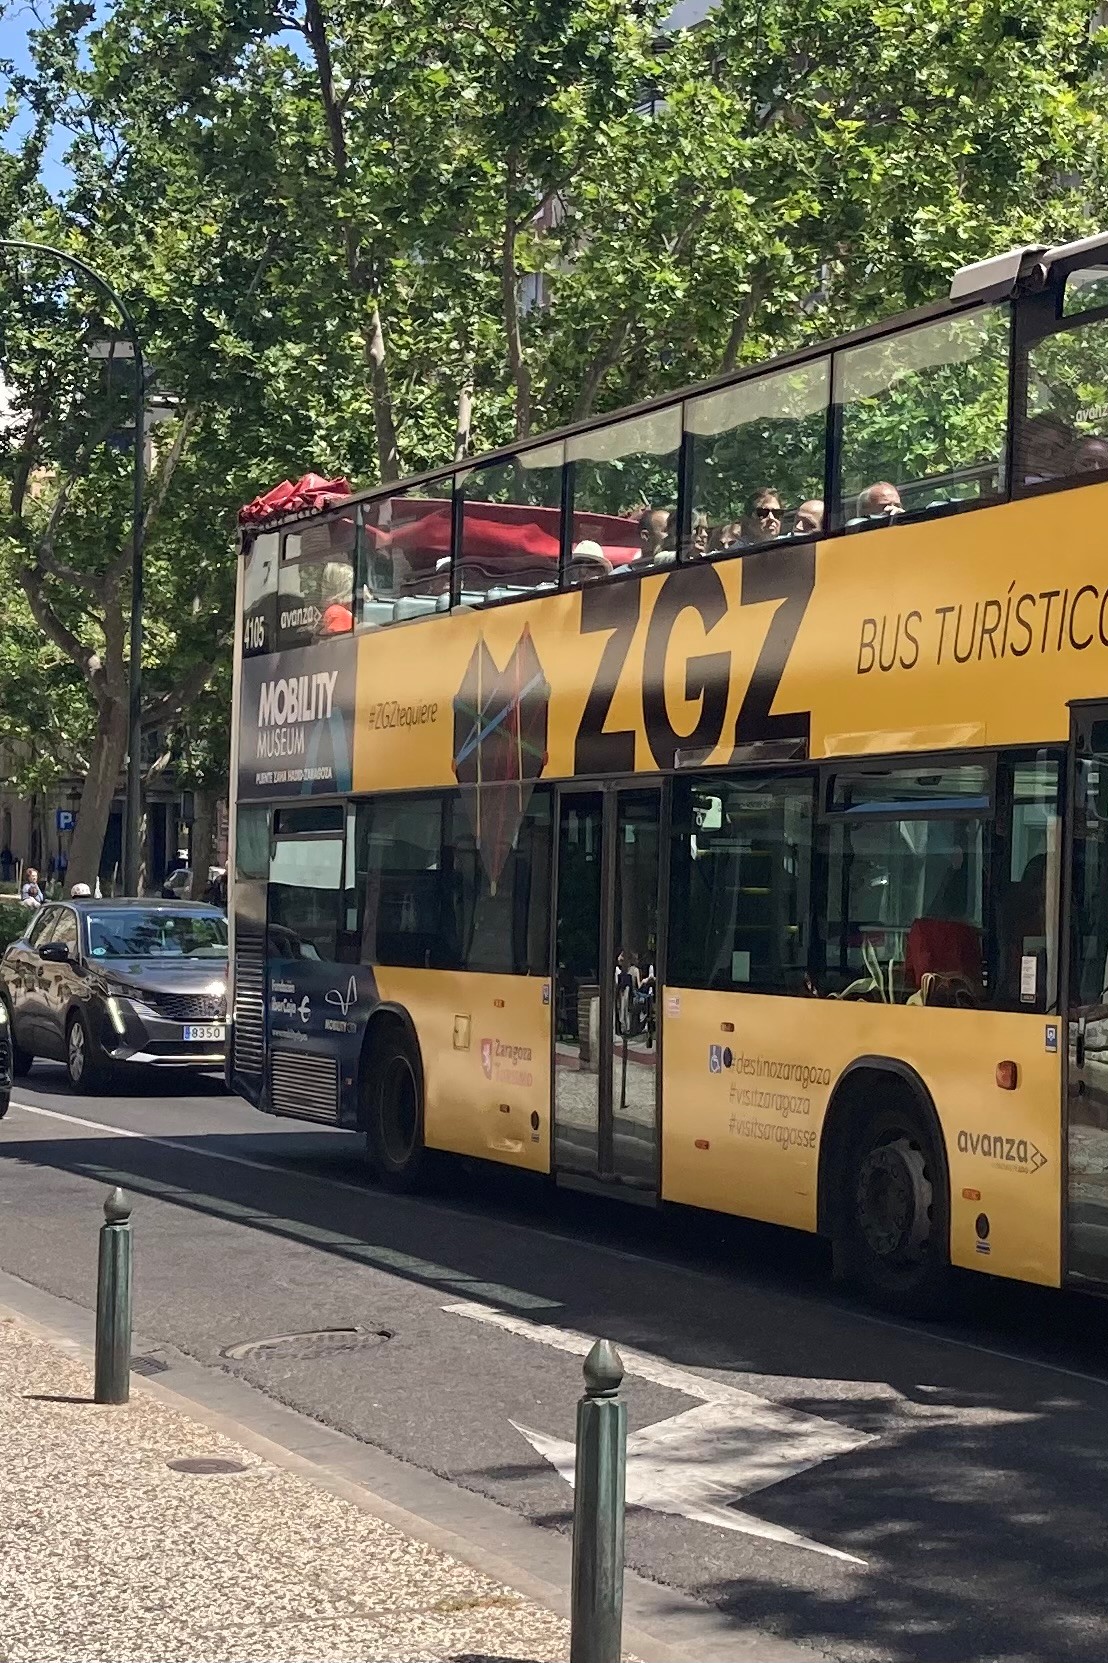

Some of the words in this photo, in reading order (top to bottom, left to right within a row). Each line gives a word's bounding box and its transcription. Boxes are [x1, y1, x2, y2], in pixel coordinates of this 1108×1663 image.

[244, 616, 265, 649] 4105
[281, 606, 314, 629] avanza
[574, 542, 817, 774] ZGZ
[857, 610, 922, 674] BUS
[258, 671, 338, 727] MOBILITY
[257, 725, 304, 758] MUSEUM
[60, 812, 72, 828] P
[191, 1027, 220, 1038] 8350
[495, 1039, 531, 1065] Zaragoza
[729, 1082, 810, 1118] #visitzaragoza
[958, 1130, 1028, 1163] avanza
